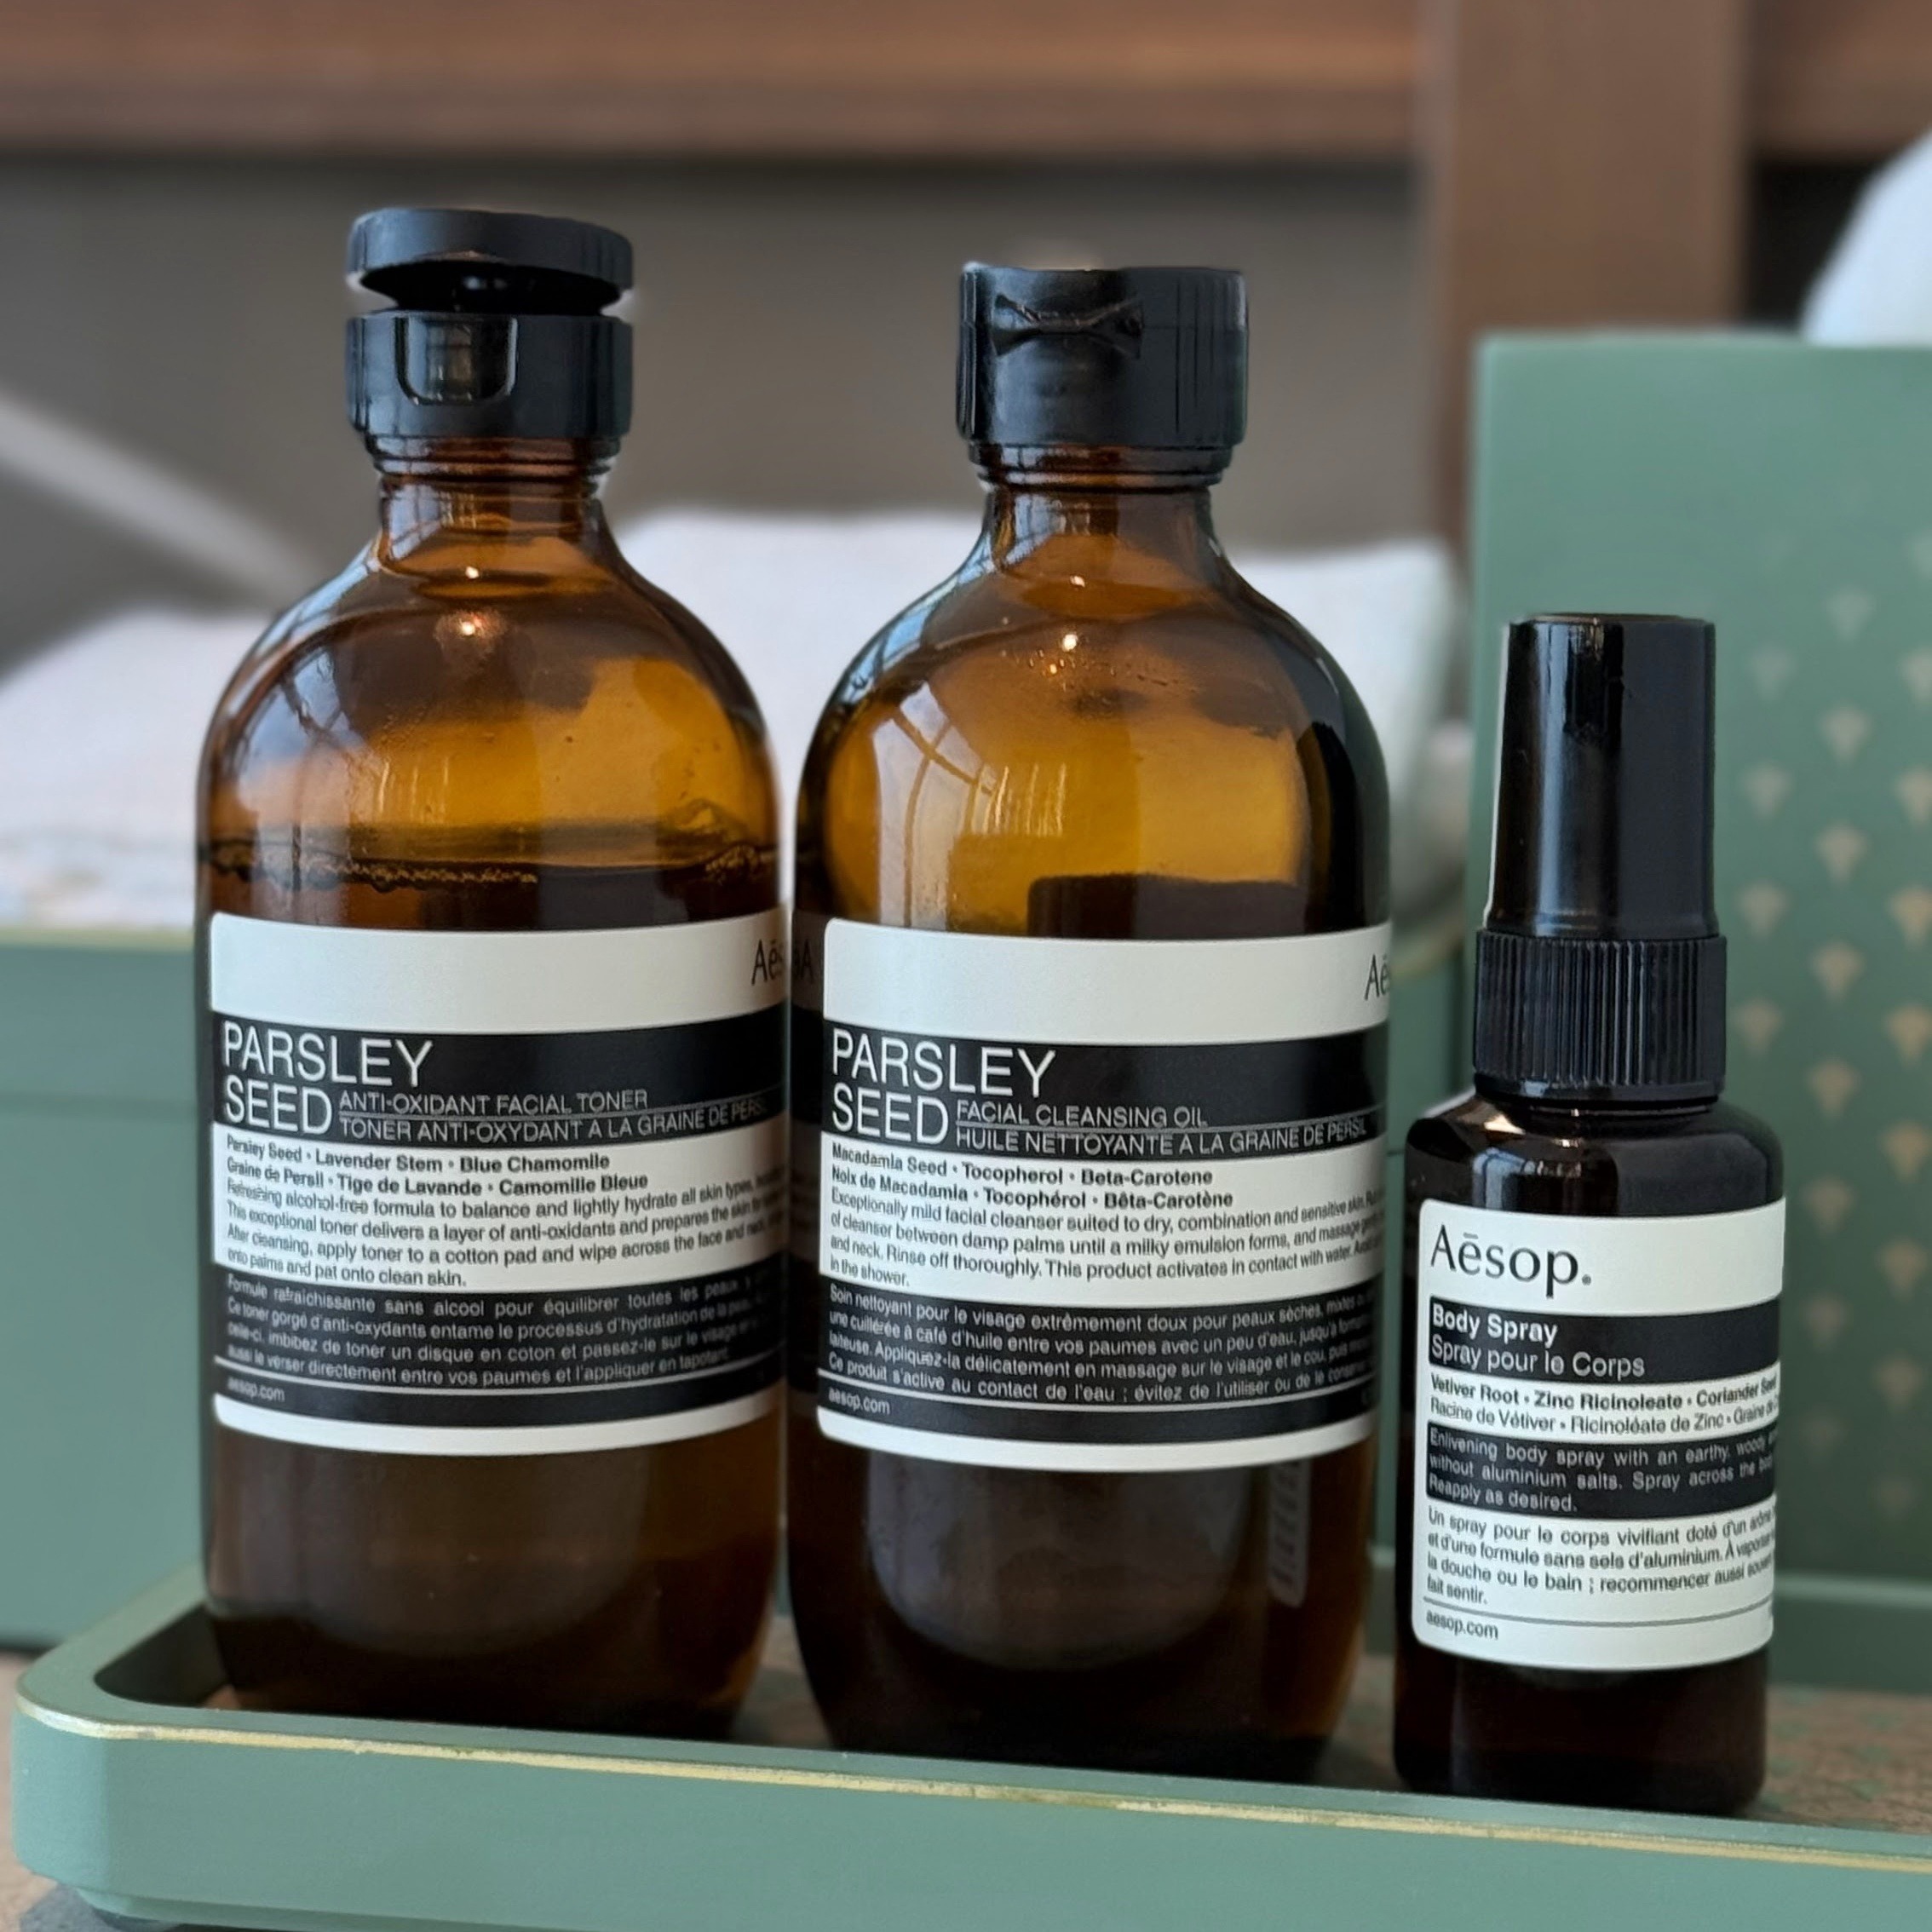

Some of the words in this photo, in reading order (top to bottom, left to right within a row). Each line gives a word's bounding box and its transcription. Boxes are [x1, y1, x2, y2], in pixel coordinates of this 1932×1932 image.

[224, 1021, 433, 1088] PARSLEY
[832, 1027, 1055, 1098] PARSLEY
[225, 1072, 332, 1135] SEED
[341, 1090, 490, 1115] ANTI-OXIDANT
[497, 1094, 572, 1114] FACIAL
[577, 1090, 647, 1113] TONER
[832, 1083, 949, 1144] SEED
[957, 1100, 1029, 1124] FACIAL
[1036, 1104, 1167, 1127] CLEANSING
[1174, 1107, 1208, 1128] OIL
[340, 1118, 411, 1141] TONER
[417, 1122, 583, 1141] ANTI-OXYDANT
[609, 1118, 631, 1138] LA
[639, 1109, 704, 1136] GRAINE
[710, 1104, 728, 1125] DE
[957, 1127, 1019, 1153] HUILE
[1026, 1131, 1173, 1155] NETTOYANTE
[1199, 1134, 1225, 1154] LA
[1230, 1127, 1299, 1153] GRAINE
[1304, 1124, 1324, 1147] DE
[316, 1150, 391, 1171] Lavender
[396, 1154, 442, 1172] Stem
[460, 1156, 502, 1173] Blue
[508, 1152, 610, 1173] Chamomile
[907, 1157, 947, 1176] Seed
[962, 1161, 1063, 1186] Tocopherol
[1082, 1168, 1212, 1187] Beta-Carotene
[265, 1165, 279, 1182] de
[337, 1174, 373, 1193] Tige
[378, 1176, 400, 1193] de
[405, 1177, 481, 1196] Lavande
[499, 1178, 595, 1196] Camomille
[601, 1174, 648, 1191] Bleue
[860, 1172, 876, 1189] de
[880, 1176, 968, 1201] Macadamia
[374, 1198, 434, 1218] formula
[440, 1203, 456, 1218] to
[463, 1200, 530, 1218] balance
[536, 1200, 567, 1217] and
[573, 1196, 619, 1222] lightly
[625, 1192, 677, 1221] hydrate
[682, 1188, 696, 1206] all
[700, 1184, 722, 1204] skin
[911, 1203, 939, 1221] mild
[946, 1206, 986, 1225] facial
[991, 1208, 1064, 1229] cleanser
[1067, 1214, 1118, 1232] suited
[1124, 1217, 1140, 1232] to
[1144, 1215, 1173, 1234] dry,
[1178, 1209, 1271, 1233] combination
[1274, 1206, 1298, 1226] and
[320, 1217, 358, 1235] toner
[362, 1221, 424, 1239] delivers
[428, 1228, 440, 1239] a
[444, 1224, 486, 1245] layer
[490, 1226, 505, 1241] of
[511, 1222, 616, 1240] anti-oxidants
[619, 1217, 648, 1235] and
[652, 1212, 710, 1234] prepares
[711, 1207, 728, 1222] the
[896, 1225, 957, 1247] between
[963, 1230, 1009, 1252] damp
[1014, 1235, 1064, 1255] palms
[1070, 1235, 1105, 1255] until
[1111, 1241, 1121, 1255] a
[1126, 1237, 1169, 1258] milky
[1175, 1234, 1245, 1253] emulsion
[1294, 1228, 1316, 1246] and
[318, 1240, 357, 1263] apply
[362, 1243, 403, 1262] toner
[408, 1247, 423, 1262] to
[428, 1251, 440, 1263] a
[446, 1247, 498, 1264] cotton
[504, 1246, 537, 1268] pad
[543, 1245, 573, 1262] and
[579, 1244, 617, 1264] wipe
[622, 1239, 670, 1257] across
[675, 1233, 695, 1251] the
[887, 1243, 926, 1265] Rinse
[930, 1251, 949, 1268] off
[953, 1251, 1042, 1277] thoroughly.
[1045, 1258, 1082, 1277] This
[1087, 1258, 1152, 1279] product
[1157, 1262, 1228, 1279] activates
[1232, 1258, 1245, 1274] in
[1249, 1252, 1297, 1273] contact
[1430, 1224, 1591, 1299] Aēsop.
[287, 1258, 311, 1277] and
[315, 1264, 336, 1282] pat
[342, 1264, 375, 1283] onto
[379, 1267, 423, 1285] clean
[428, 1269, 466, 1286] skin.
[384, 1298, 423, 1315] sans
[434, 1299, 485, 1317] alcool
[495, 1302, 533, 1319] pour
[544, 1295, 618, 1317] équilibrer
[629, 1291, 672, 1308] toutes
[917, 1305, 949, 1322] pour
[955, 1305, 967, 1322] le
[973, 1309, 1025, 1331] visage
[1147, 1314, 1187, 1331] doux
[1193, 1314, 1228, 1335] pour
[1233, 1311, 1274, 1332] peaux
[1433, 1303, 1480, 1333] Body
[1487, 1311, 1558, 1348] Spray
[1432, 1333, 1481, 1368] Spray
[1488, 1348, 1538, 1374] pour
[1544, 1350, 1564, 1375] le
[1573, 1352, 1644, 1382] Corps
[309, 1361, 396, 1382] directement
[401, 1367, 443, 1384] entre
[449, 1370, 477, 1384] vos
[483, 1370, 550, 1387] paumes
[555, 1367, 572, 1383] et
[952, 1377, 970, 1393] au
[978, 1380, 1038, 1399] contact
[1046, 1383, 1067, 1400] de
[829, 1388, 889, 1414] aesop.com
[1431, 1372, 1476, 1398] Vetiver
[1481, 1384, 1520, 1404] Root
[1534, 1390, 1574, 1408] Zinc
[1580, 1393, 1682, 1411] Ricinoleate
[1476, 1407, 1495, 1424] de
[1499, 1409, 1556, 1430] Vétiver
[1670, 1415, 1690, 1432] de
[1693, 1412, 1723, 1431] Zinc
[1506, 1441, 1548, 1467] body
[1556, 1449, 1605, 1469] spray
[1613, 1449, 1648, 1466] with
[1658, 1450, 1677, 1465] an
[1429, 1473, 1481, 1504] Reapply
[1486, 1489, 1504, 1505] as
[1509, 1490, 1577, 1512] desired.
[1481, 1463, 1566, 1488] aluminium
[1577, 1471, 1623, 1490] salts.
[1633, 1471, 1681, 1492] Spray
[1689, 1467, 1734, 1486] across
[1429, 1505, 1445, 1526] Un
[1450, 1515, 1486, 1539] spray
[1494, 1523, 1531, 1541] pour
[1538, 1525, 1552, 1544] le
[1561, 1531, 1610, 1550] corps
[1617, 1527, 1680, 1546] vivifiant
[1686, 1522, 1716, 1542] doté
[1481, 1542, 1539, 1566] formule
[1544, 1554, 1584, 1569] sans
[1590, 1552, 1624, 1570] sels
[1441, 1558, 1492, 1583] douche
[1497, 1570, 1517, 1587] ou
[1524, 1570, 1538, 1589] le
[1545, 1573, 1582, 1592] bain
[1600, 1573, 1710, 1593] recommencer
[1427, 1610, 1498, 1640] aesop.com
